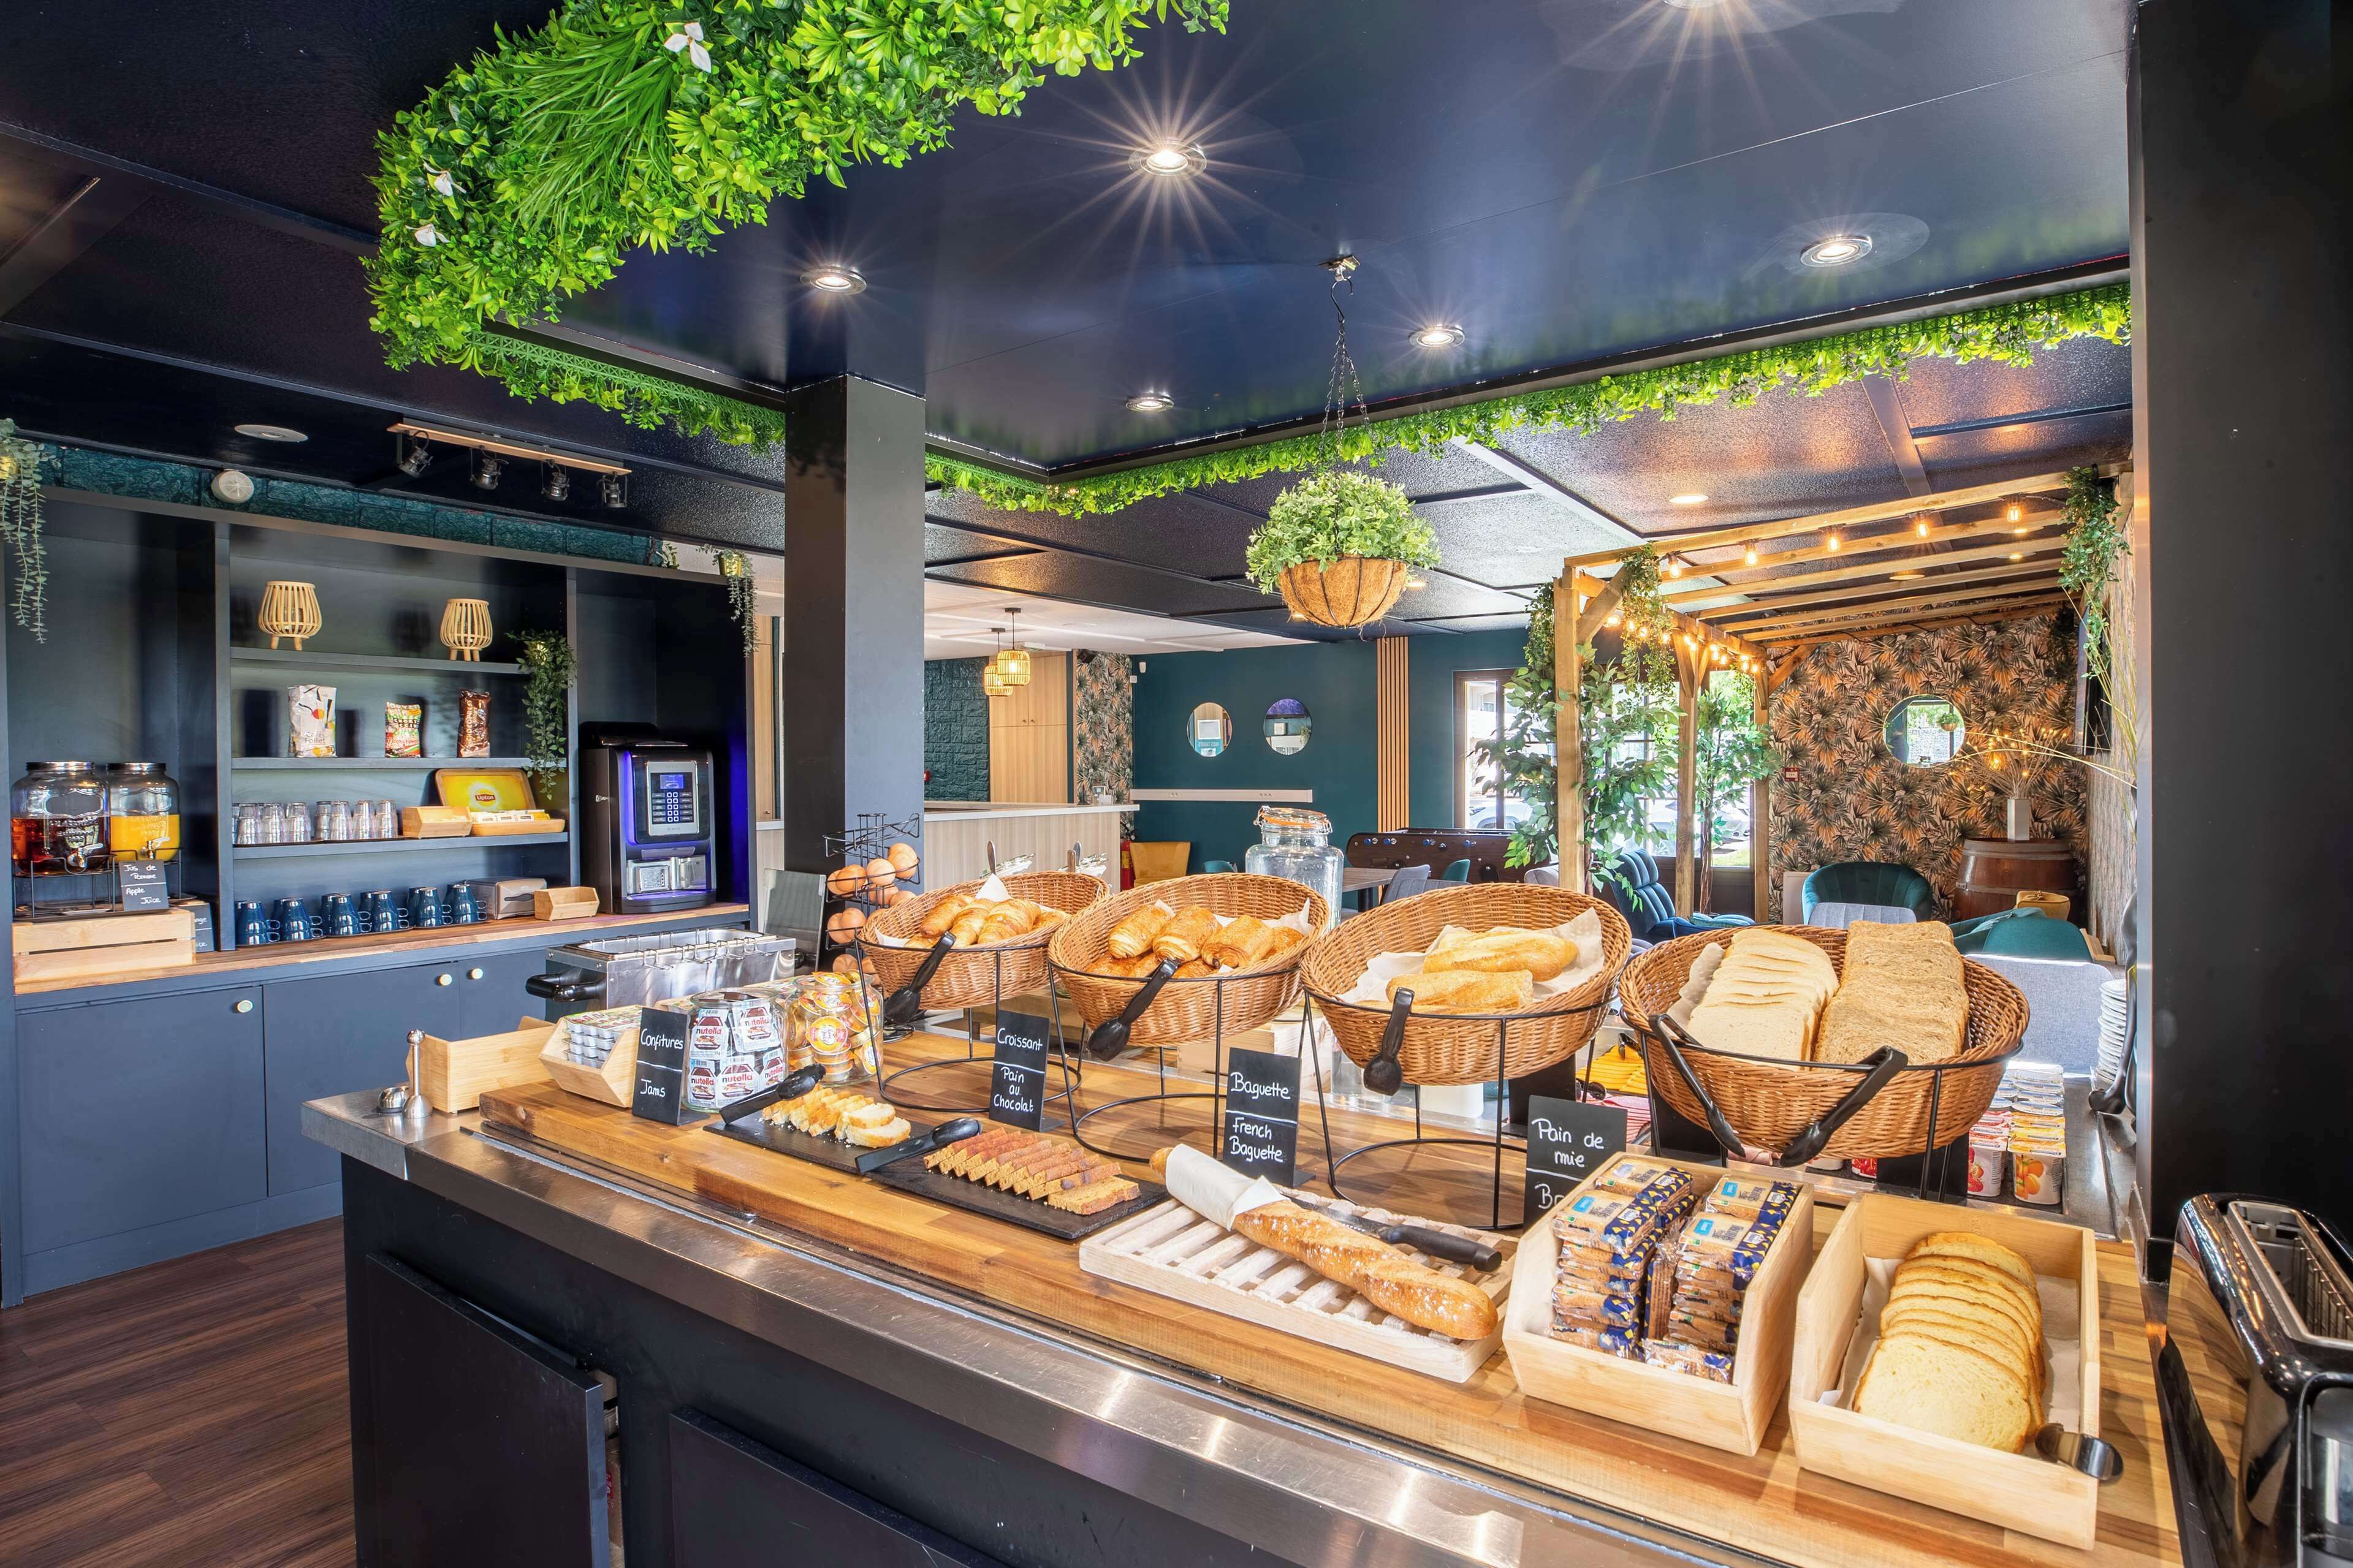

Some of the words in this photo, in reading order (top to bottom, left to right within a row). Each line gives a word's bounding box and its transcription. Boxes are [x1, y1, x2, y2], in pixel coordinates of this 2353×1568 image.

[640, 1028, 684, 1050] Confitures
[696, 1026, 722, 1034] nutella
[997, 1028, 1043, 1051] Croissant
[722, 1074, 753, 1083] nutella
[764, 1066, 783, 1078] nutella
[1000, 1066, 1024, 1083] Pain
[640, 1078, 666, 1097] Jams
[1009, 1085, 1020, 1096] au
[1230, 1072, 1291, 1099] Baguette
[994, 1094, 1033, 1112] Chocolat
[1232, 1116, 1272, 1140] French
[1531, 1118, 1572, 1143] Pain
[1583, 1132, 1605, 1149] de
[1229, 1135, 1283, 1162] Baguette
[1554, 1151, 1585, 1168] mie
